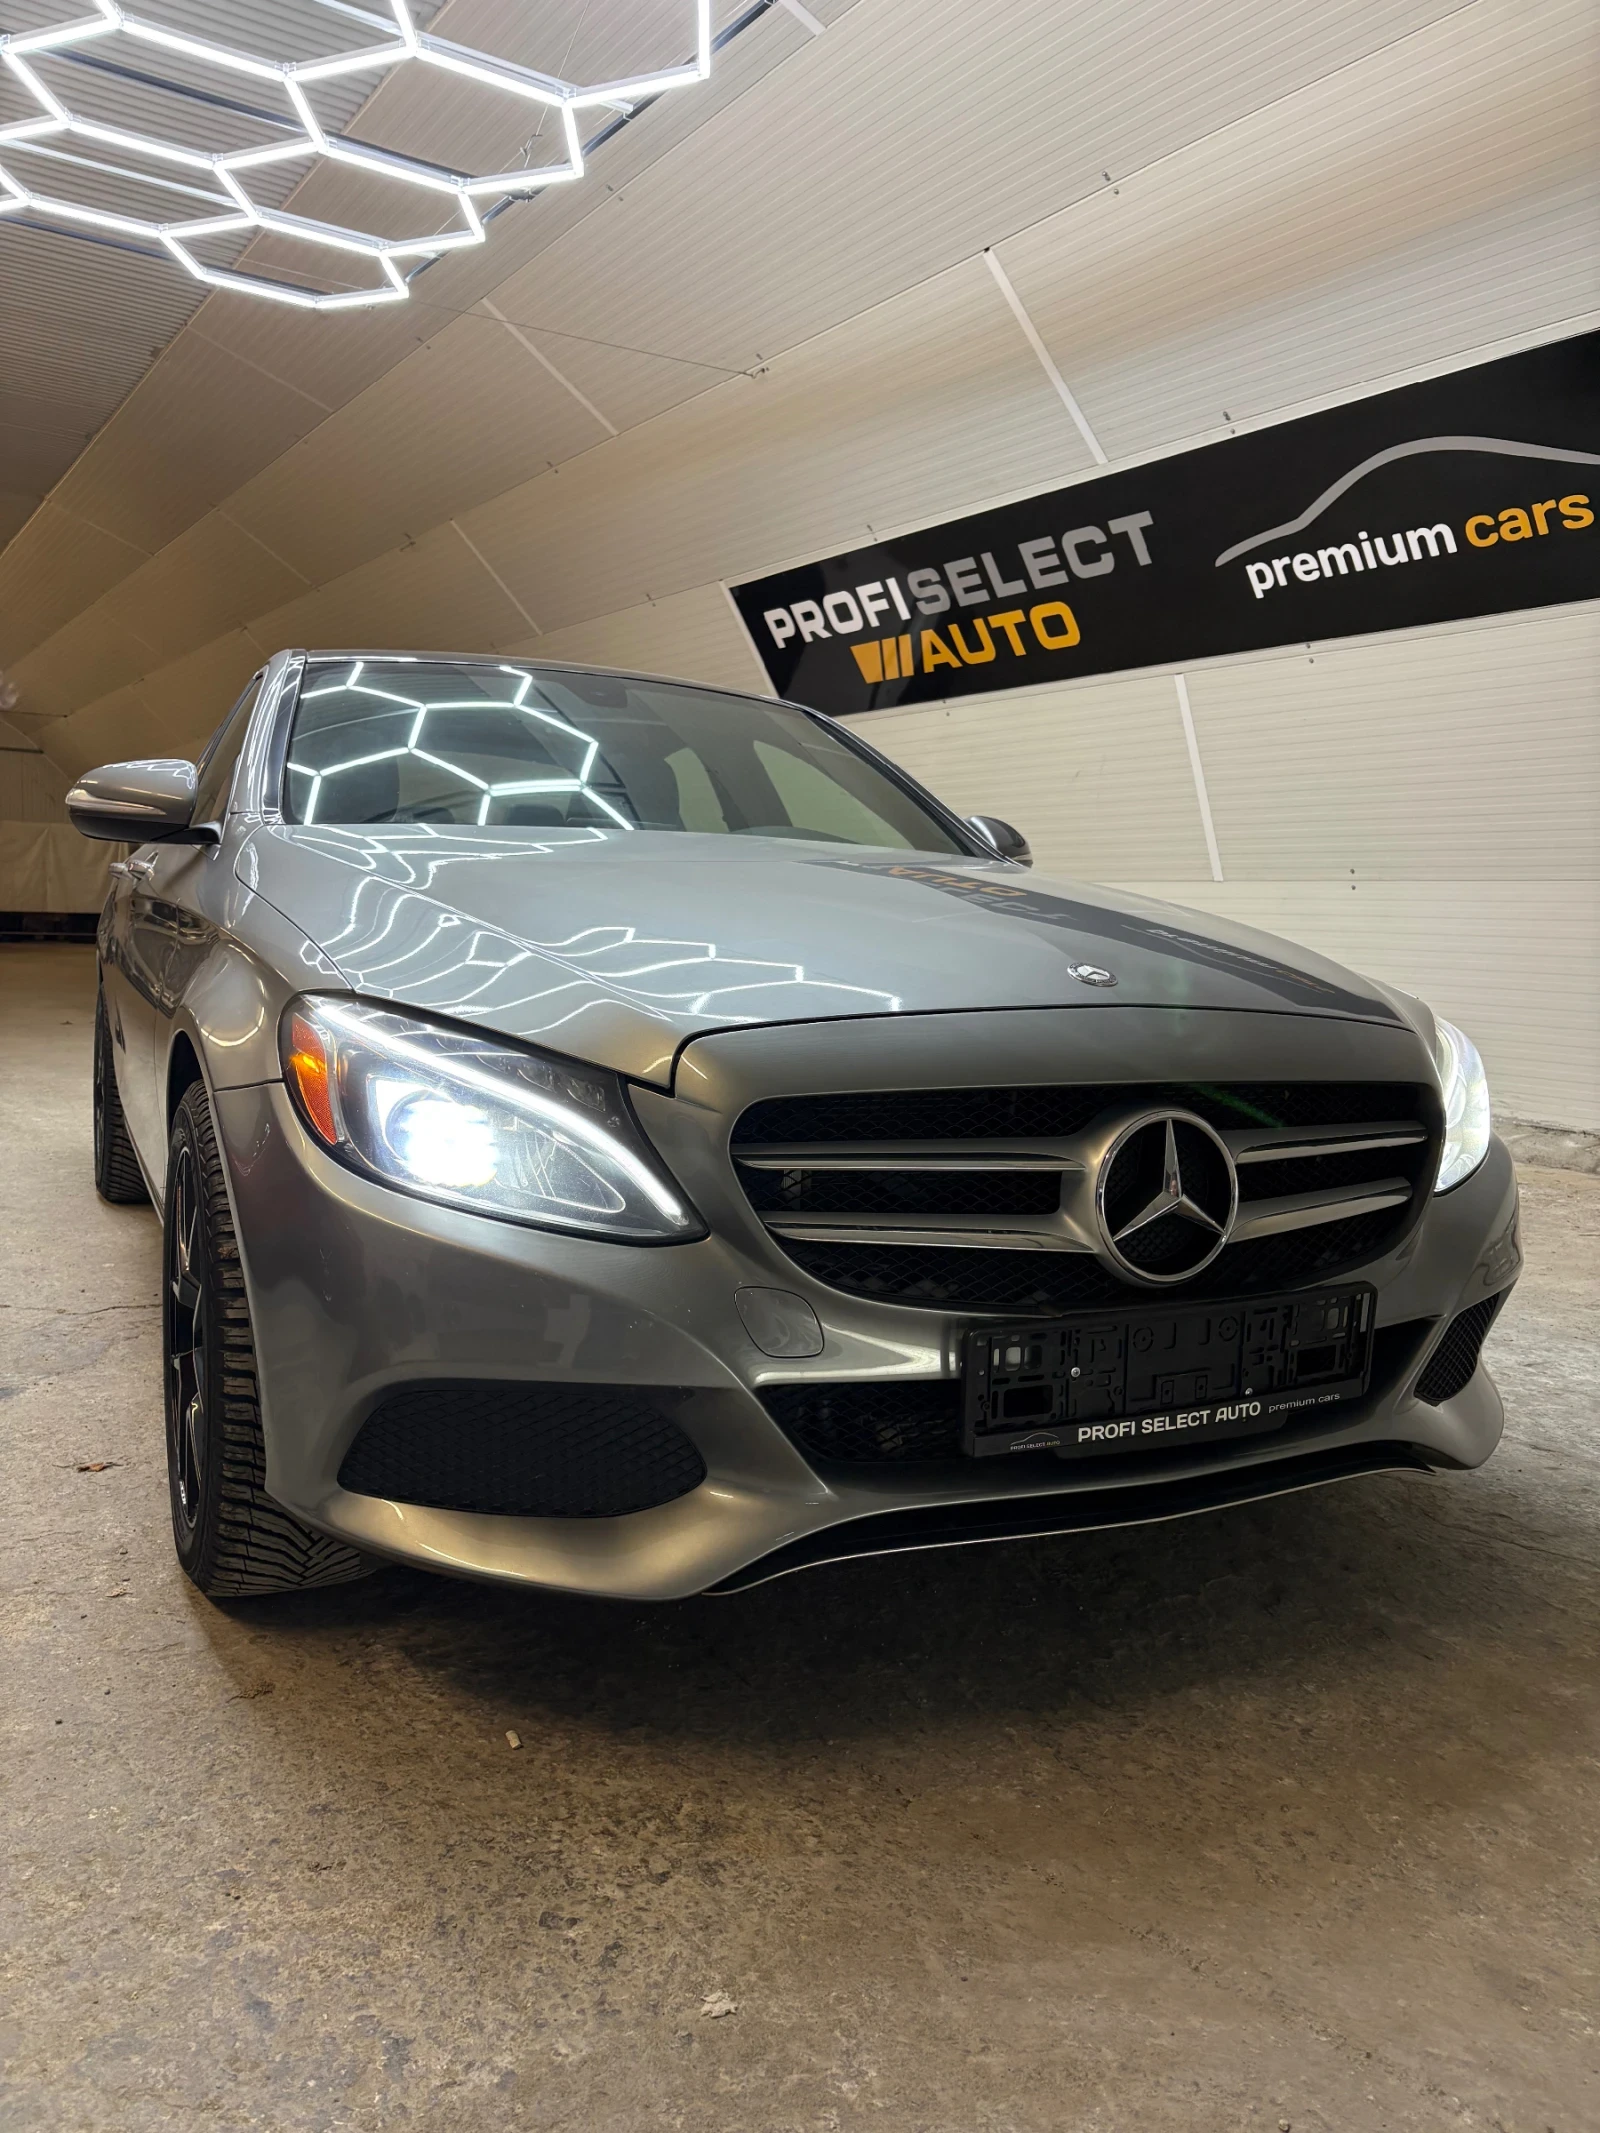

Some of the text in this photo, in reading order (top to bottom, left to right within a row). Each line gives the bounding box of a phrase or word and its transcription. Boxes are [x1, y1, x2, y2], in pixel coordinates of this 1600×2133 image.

[1245, 494, 1595, 599] premium cars
[920, 600, 1081, 674] AUTO
[1077, 1401, 1261, 1443] PROFI SELECT AUTO
[1268, 1393, 1341, 1414] premium cars
